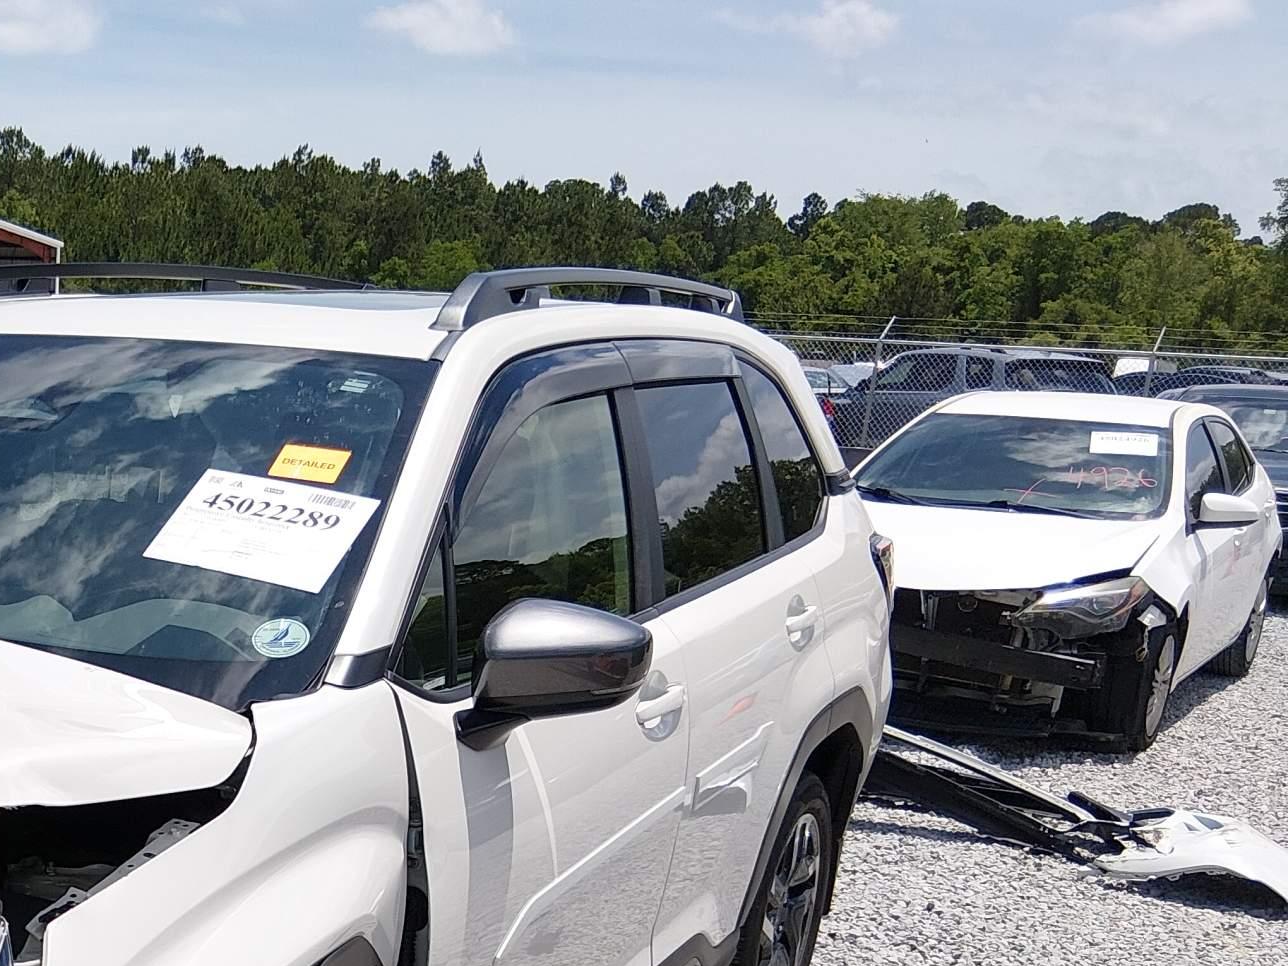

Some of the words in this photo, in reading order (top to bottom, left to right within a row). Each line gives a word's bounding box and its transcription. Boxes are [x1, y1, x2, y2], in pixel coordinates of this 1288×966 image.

[281, 457, 337, 470] DETAILED
[1067, 466, 1158, 491] 4926
[202, 492, 341, 531] 45022289
